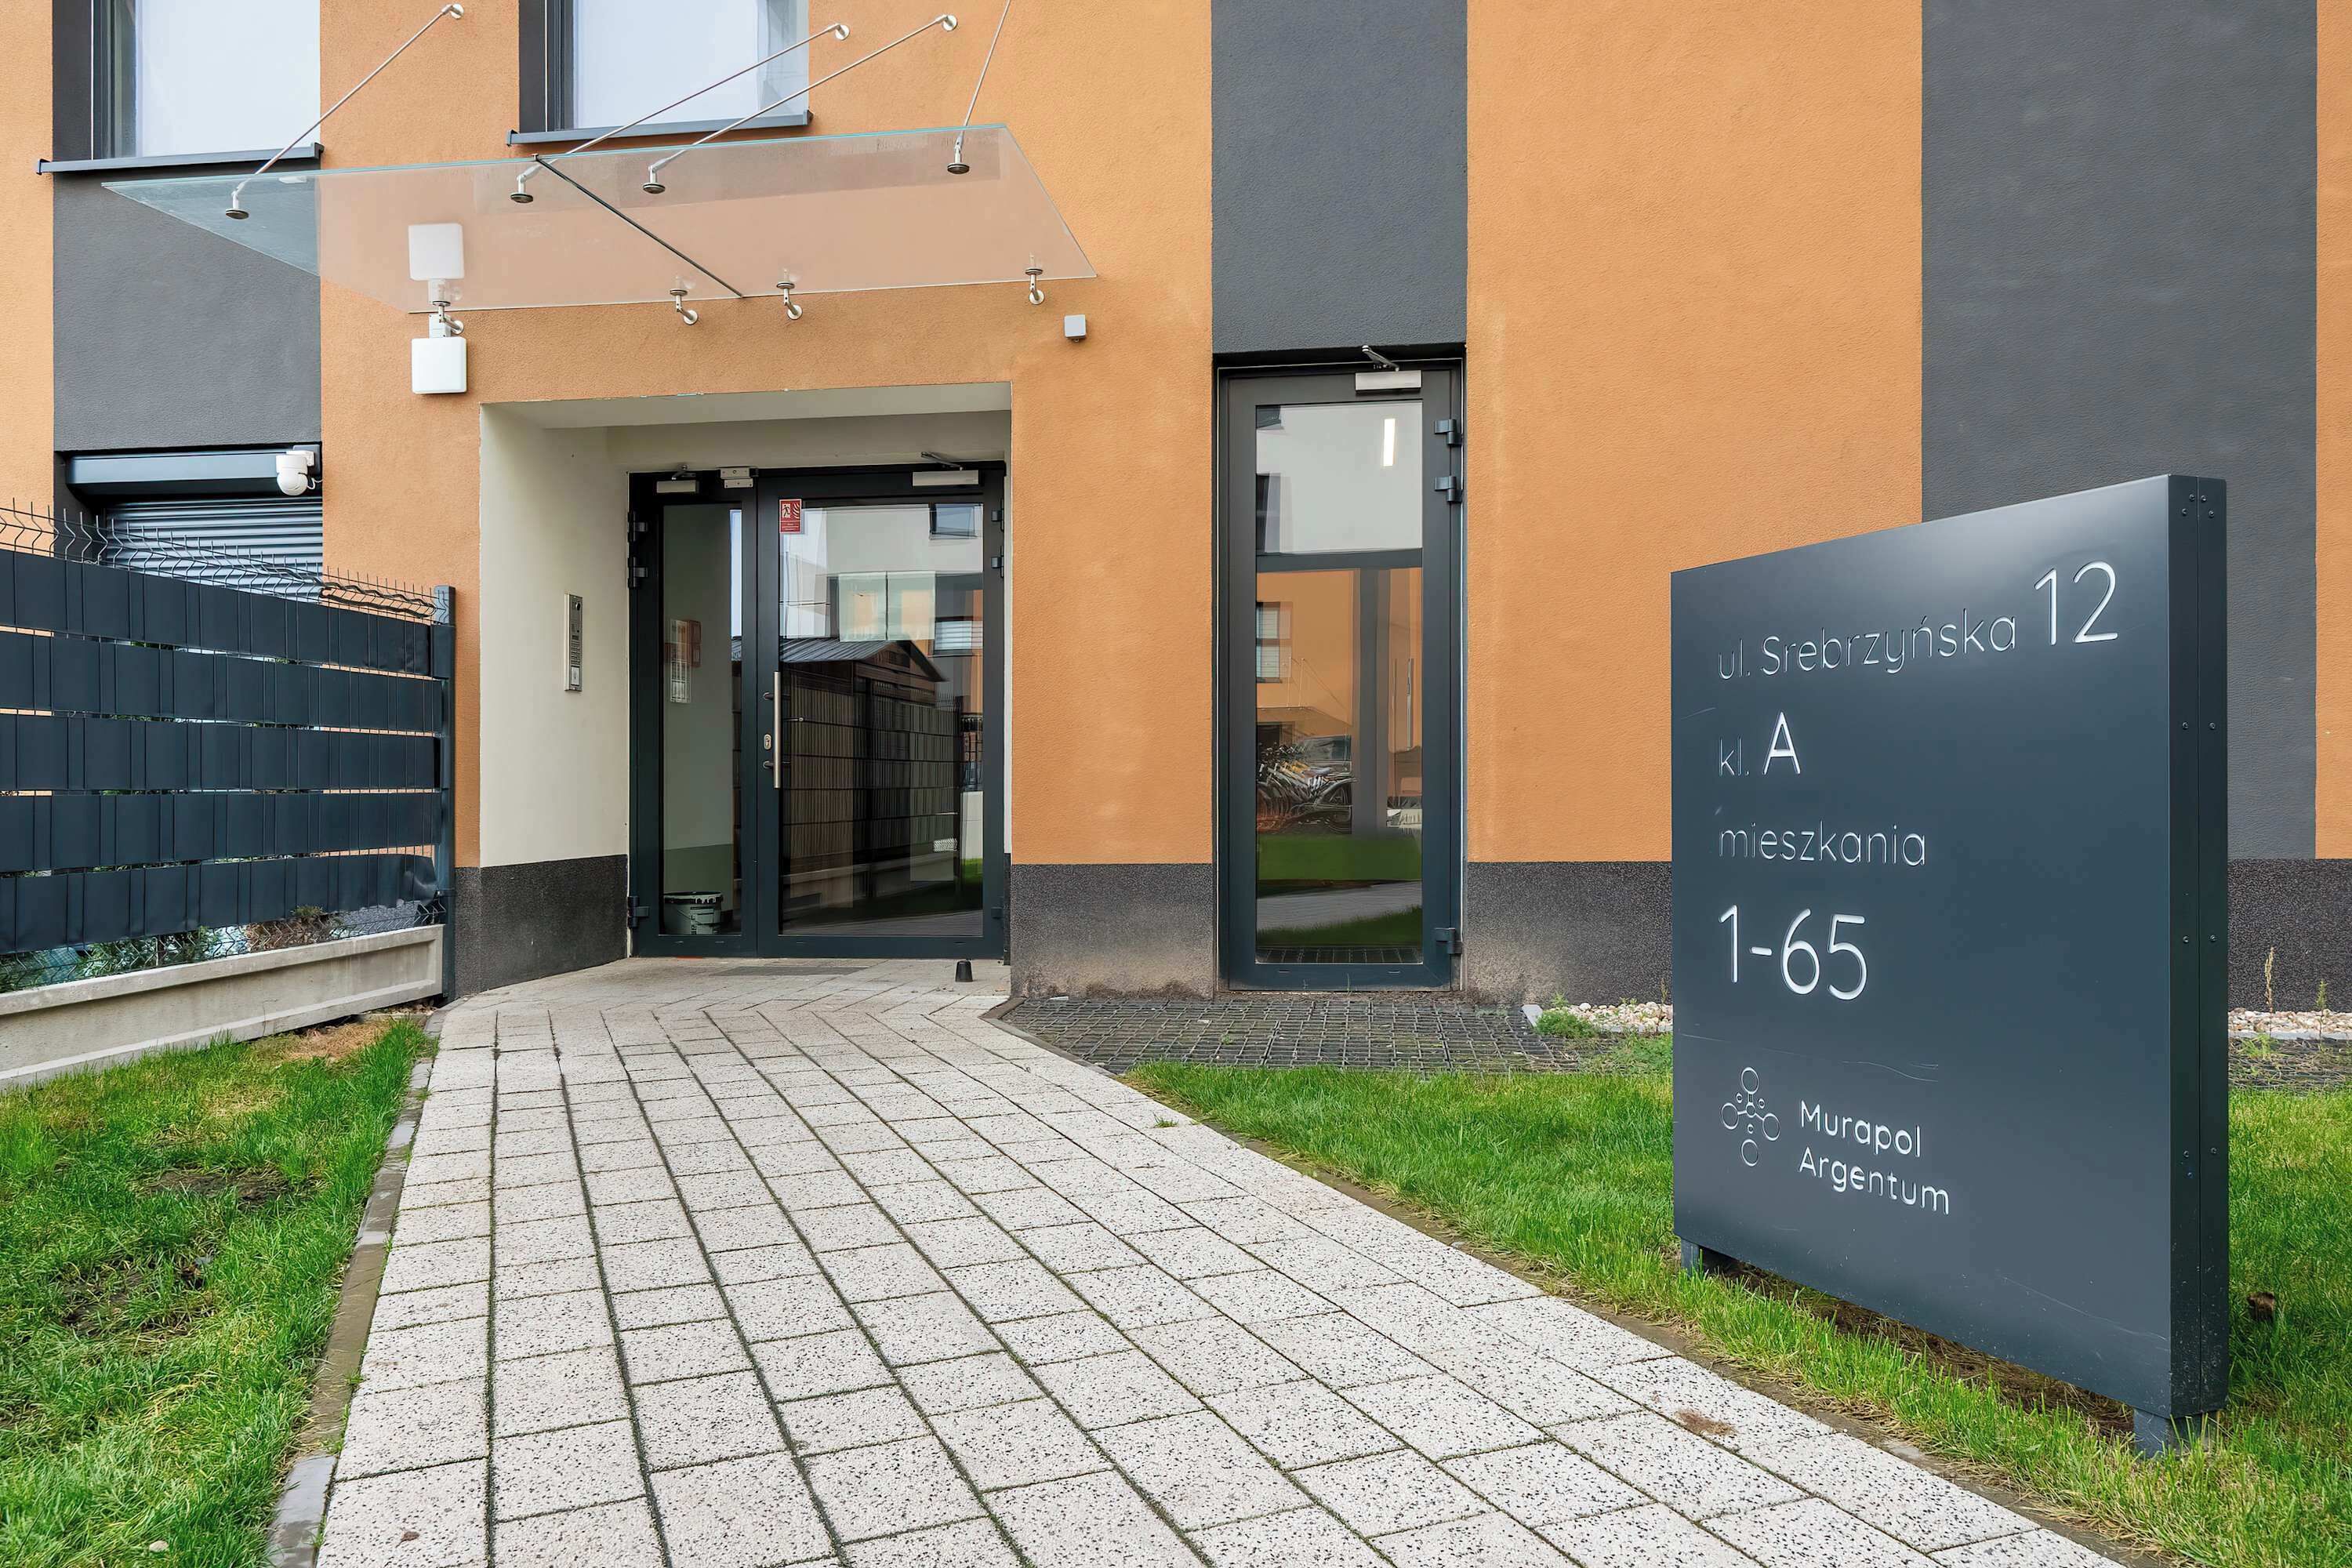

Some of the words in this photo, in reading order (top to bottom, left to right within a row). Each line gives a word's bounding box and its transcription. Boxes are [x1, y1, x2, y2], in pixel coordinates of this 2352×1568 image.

[1719, 640, 1751, 681] ul.
[1761, 608, 2017, 676] Srebrzyńska
[2034, 561, 2118, 646] 12
[1719, 738, 1750, 777] kl.
[1762, 712, 1802, 775] A
[1719, 821, 1926, 866] mieszkania
[1719, 905, 1867, 1000] 1-65
[1800, 1100, 1922, 1158] Murapol
[1799, 1147, 1951, 1214] Argentum
